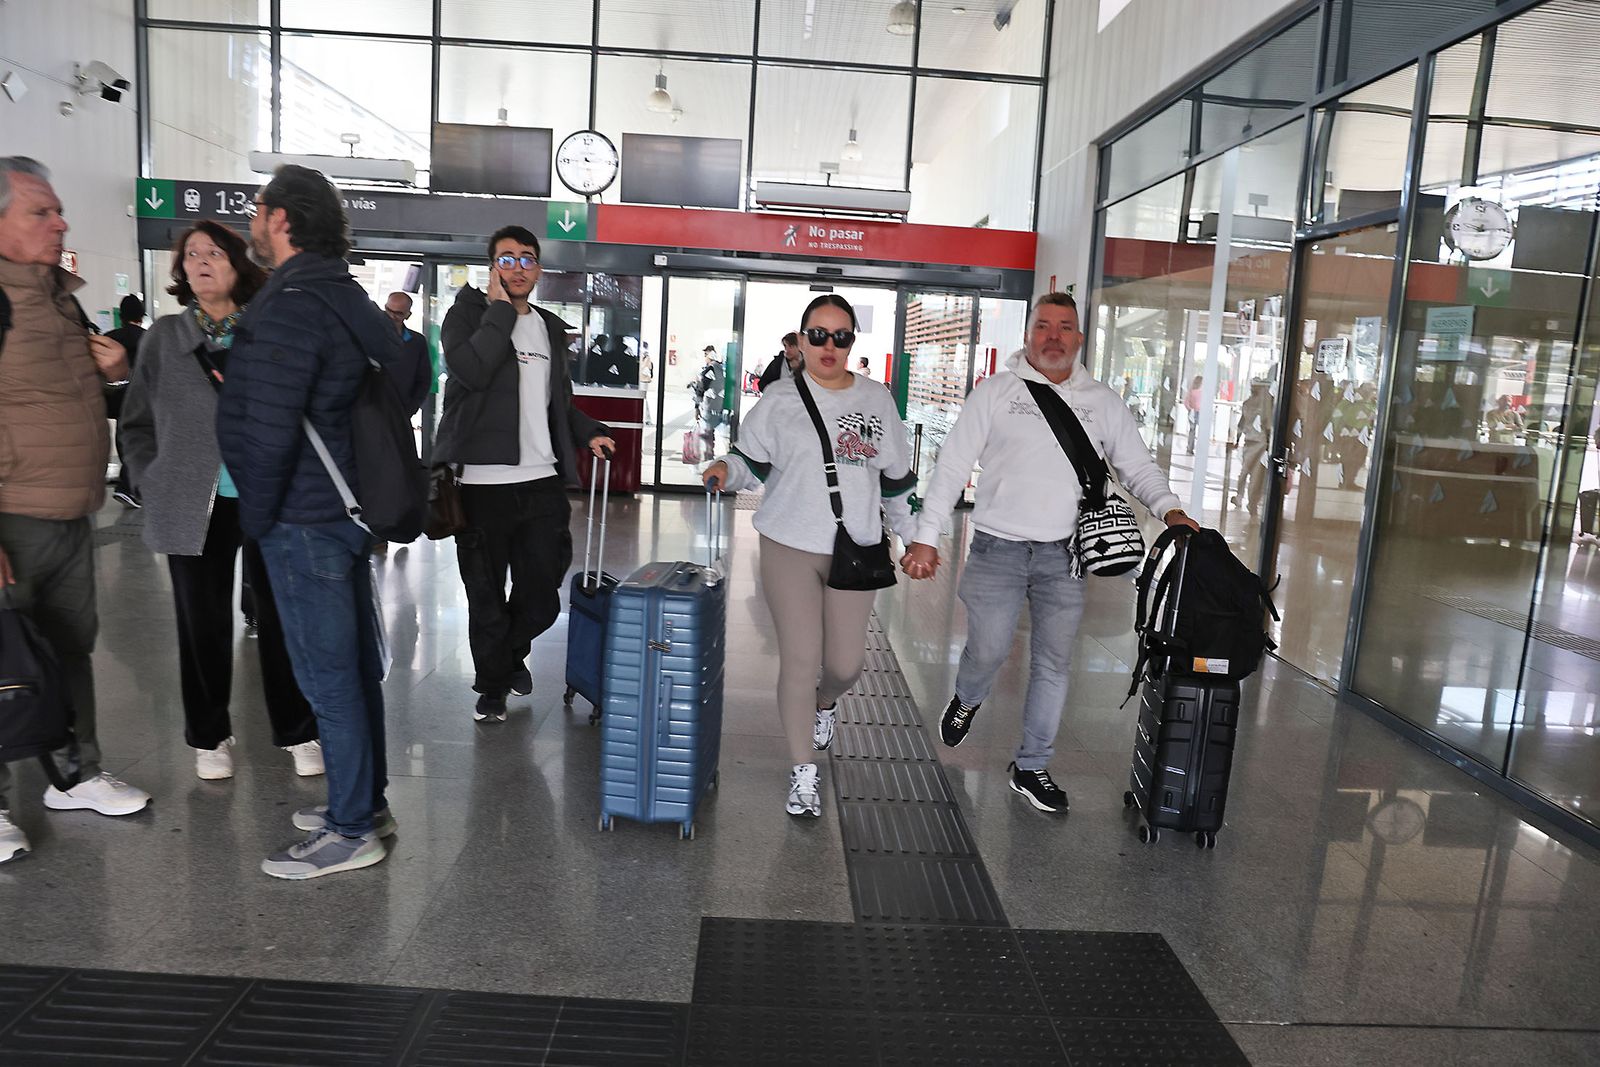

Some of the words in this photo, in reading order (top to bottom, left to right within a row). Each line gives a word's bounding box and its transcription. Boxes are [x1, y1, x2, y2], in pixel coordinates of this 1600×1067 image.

[351, 196, 377, 210] vías
[809, 225, 826, 238] No
[829, 228, 864, 241] pasar
[808, 241, 818, 249] NO
[820, 242, 864, 252] TRESPASSING
